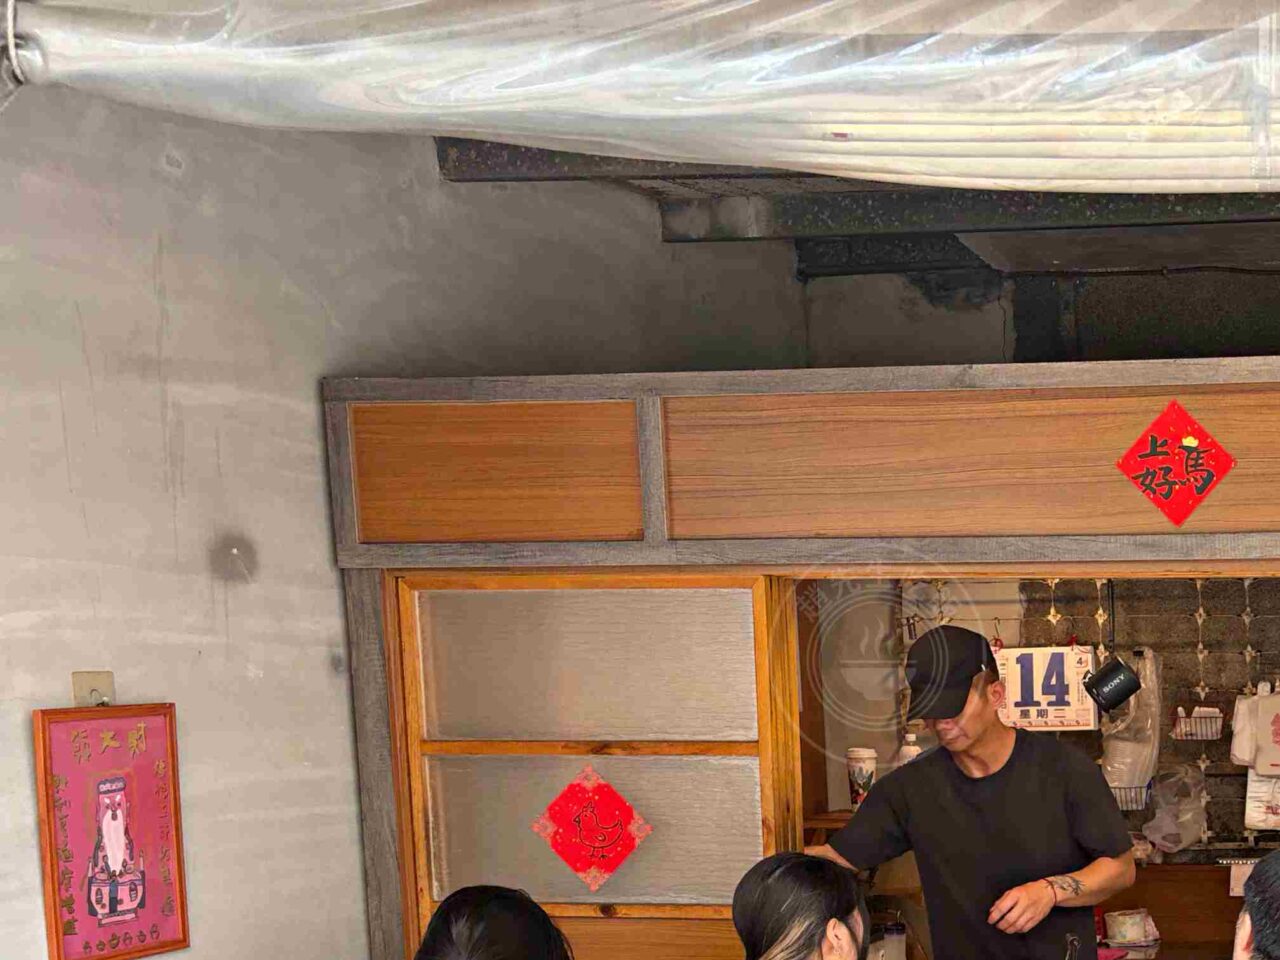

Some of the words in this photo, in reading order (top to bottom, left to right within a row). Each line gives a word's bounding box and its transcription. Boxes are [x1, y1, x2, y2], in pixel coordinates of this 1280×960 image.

[1131, 434, 1178, 500] 上好
[1014, 652, 1070, 708] 14
[1103, 673, 1125, 694] SONY
[1019, 708, 1066, 719] 星期二
